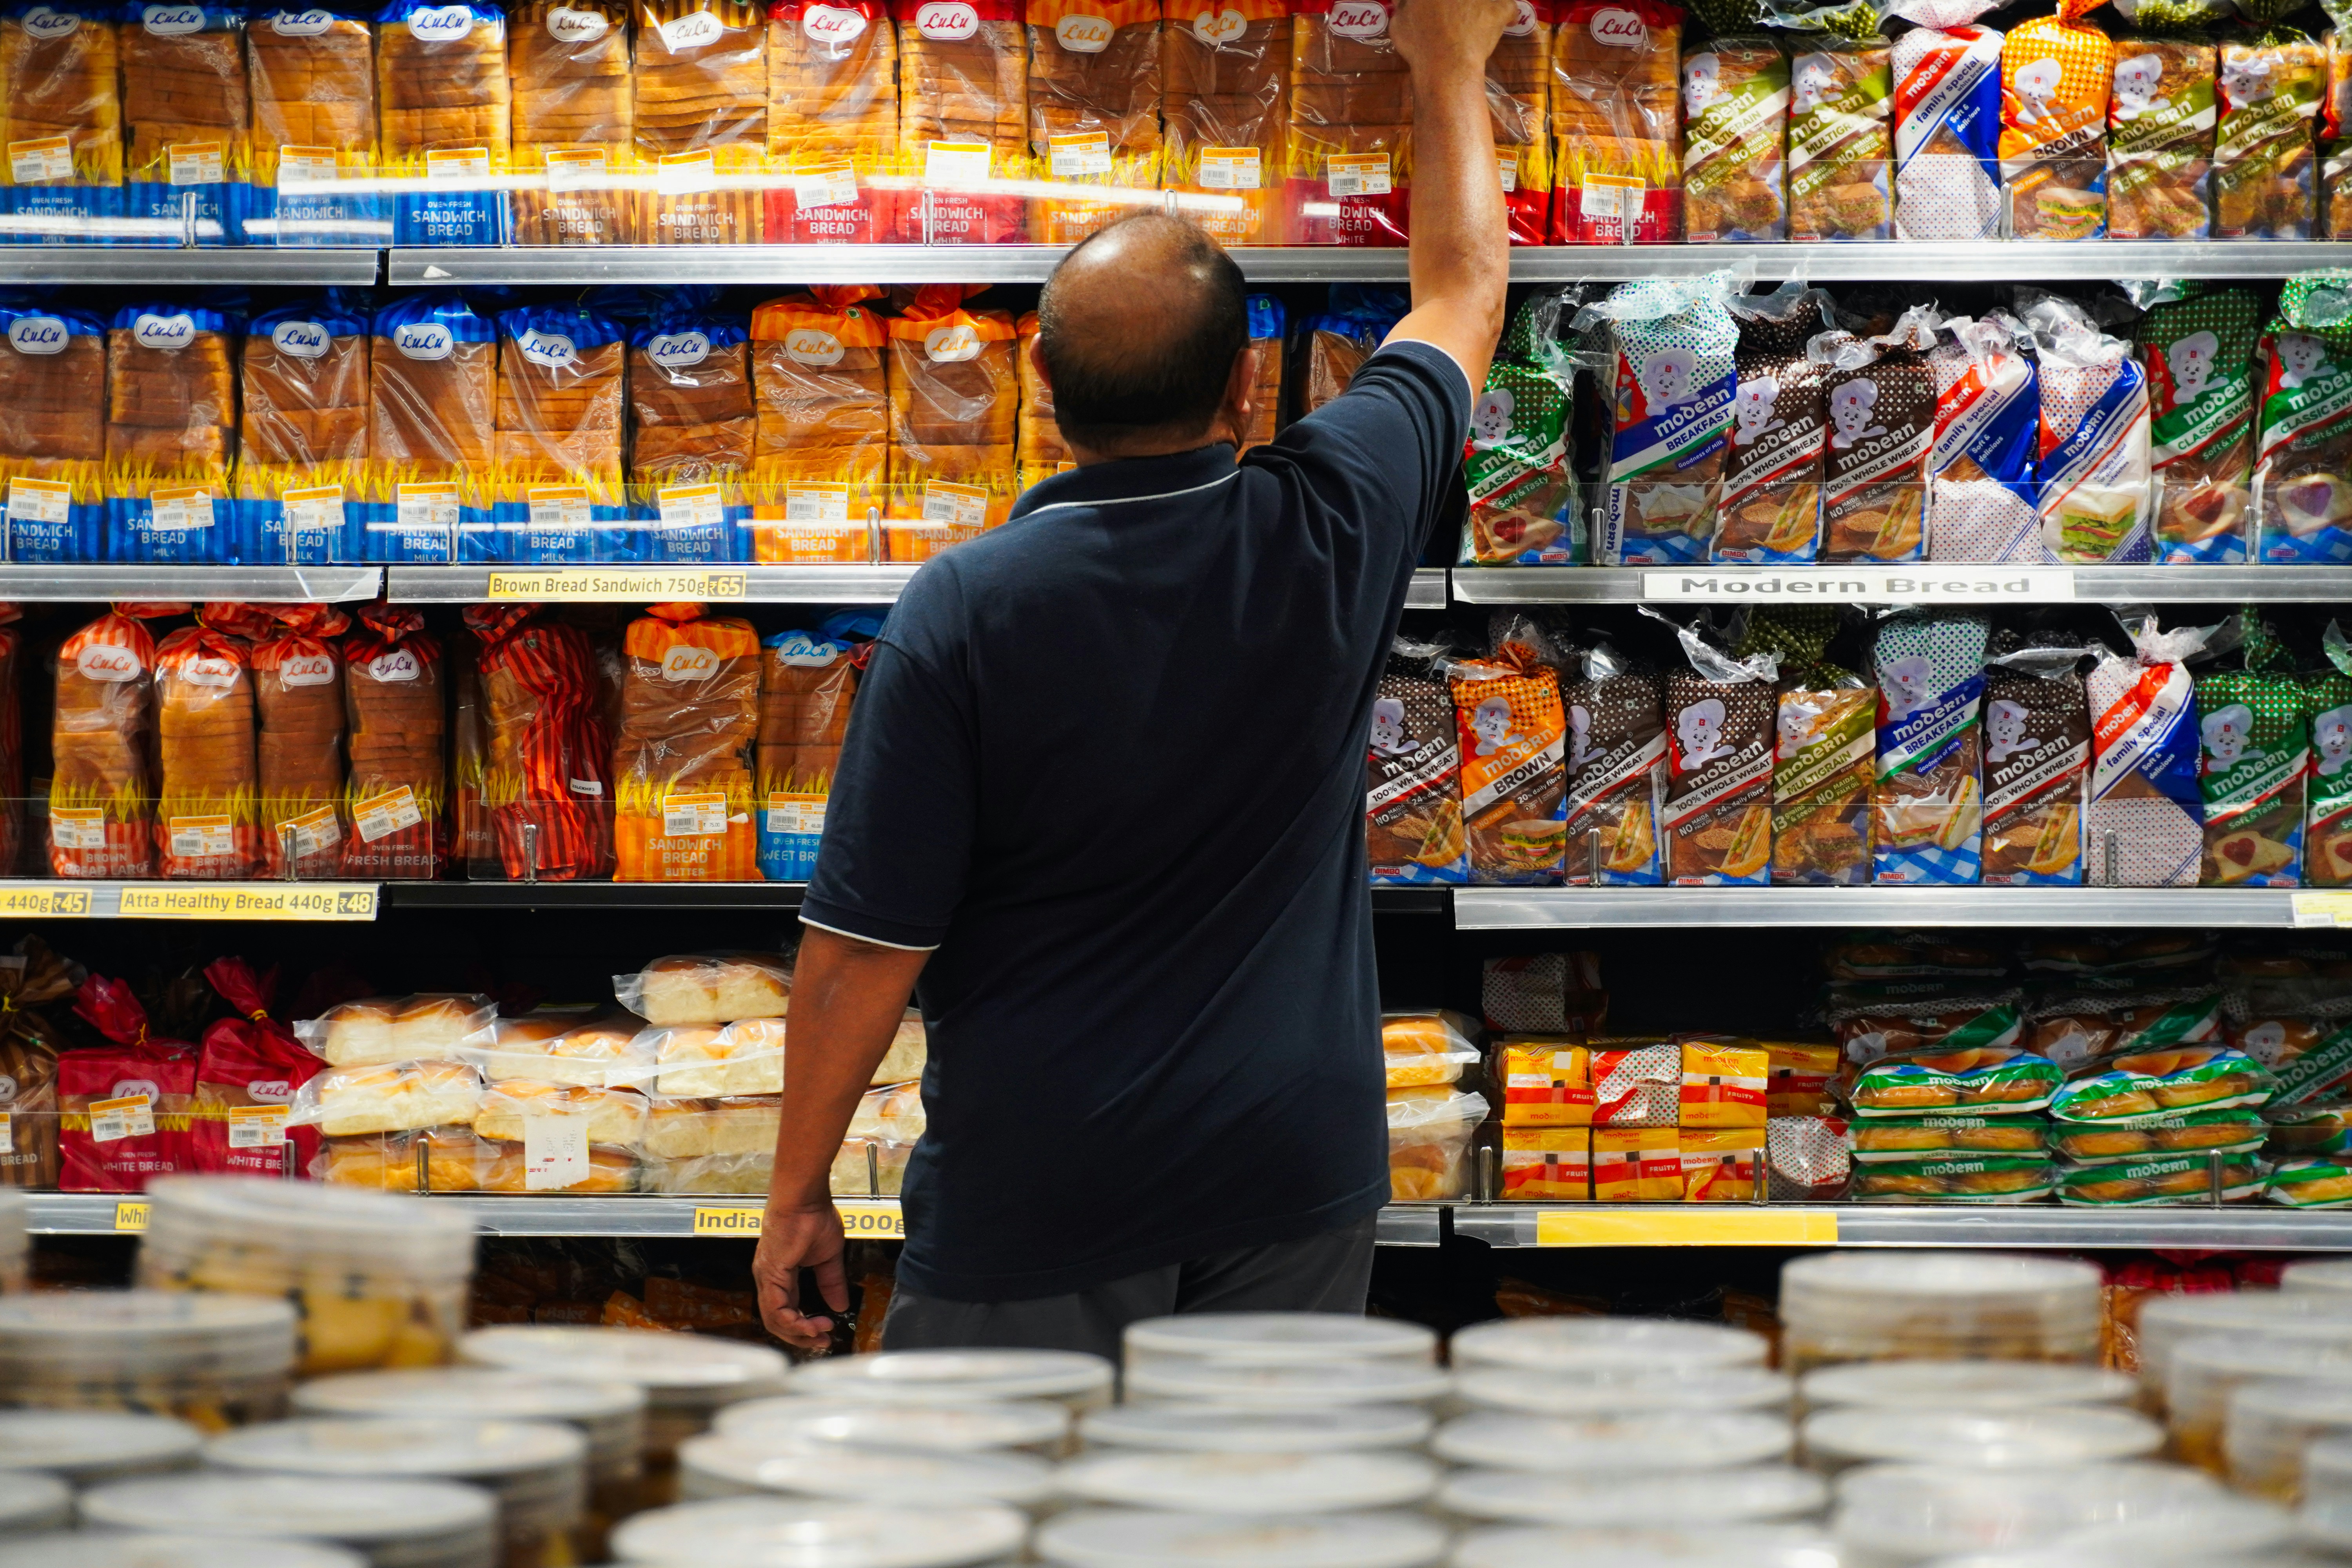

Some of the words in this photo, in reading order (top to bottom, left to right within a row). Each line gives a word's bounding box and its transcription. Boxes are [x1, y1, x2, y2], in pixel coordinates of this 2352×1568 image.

[28, 13, 74, 30] LuLu
[150, 11, 198, 25] LuLu
[417, 15, 464, 29] LuLu
[810, 15, 858, 31] LuLu
[924, 13, 969, 29] LuLu
[1333, 10, 1380, 27] LuLu
[1062, 24, 1107, 41] LuLu
[1598, 19, 1642, 36] LuLu
[1906, 49, 1951, 98] modern
[1687, 92, 1755, 142] modern
[2118, 100, 2193, 143] modern
[1699, 111, 1762, 154] MULTIGRAIN
[2126, 122, 2196, 154] MULTIGRAIN
[17, 207, 88, 219] SANDWICH
[412, 210, 486, 223] SANDWICH
[543, 207, 616, 221] SANDWICH
[660, 212, 733, 226] SANDWICH
[795, 209, 868, 221] SANDWICH
[428, 224, 473, 236] BREAD
[558, 221, 603, 233] BREAD
[809, 222, 855, 234] BREAD
[1329, 218, 1372, 231] BREAD
[673, 227, 719, 239] BREAD
[17, 328, 61, 342] LuLu
[142, 323, 186, 337] LuLu
[401, 334, 445, 348] LuLu
[525, 339, 567, 358] LuLu
[655, 340, 701, 356] LuLu
[1653, 388, 1730, 437] modern
[1740, 416, 1815, 466] modern
[2063, 409, 2106, 457] modern
[1837, 423, 1916, 470] modern
[1728, 472, 1752, 491] 100%
[1751, 451, 1786, 475] WHOLE
[1826, 478, 1851, 494] 100%
[1851, 457, 1886, 481] WHOLE
[1607, 488, 1621, 550] modern
[141, 532, 186, 544] BREAD
[654, 528, 723, 540] SANDWICH
[531, 537, 575, 549] BREAD
[667, 541, 710, 553] BREAD
[791, 539, 836, 551] BREAD
[493, 579, 539, 592] Brown
[545, 579, 587, 592] Bread
[593, 578, 662, 592] Sandwich
[668, 579, 705, 596] 750g
[1681, 578, 1866, 593] Modern
[1886, 578, 2030, 593] Bread
[785, 643, 828, 657] LuLu
[85, 655, 132, 671] LuLu
[287, 661, 328, 676] LuLu
[1893, 694, 1966, 742] modern
[1482, 730, 1554, 777] modern
[1775, 733, 1846, 784] modern
[1993, 735, 2070, 785] modern
[1688, 741, 1764, 788] modern
[2212, 749, 2289, 796] modern
[1787, 751, 1852, 795] MULTIGRAIN
[1675, 795, 1701, 811] 100%
[1700, 776, 1736, 799] WHOLE
[649, 838, 722, 851] SANDWICH
[394, 856, 438, 865] BREAD
[662, 852, 708, 864] BREAD
[7, 896, 49, 913] 440g
[125, 893, 158, 908] Atta
[165, 894, 230, 911] Healthy
[236, 894, 283, 909] Bread
[289, 895, 333, 913] 440g
[2275, 1039, 2352, 1093] modern
[1929, 1076, 1989, 1086] modern
[254, 1083, 288, 1097] LuLu
[1923, 1118, 1985, 1127] modern
[139, 1161, 173, 1172] BREAD
[2127, 1161, 2189, 1177] modern
[121, 1209, 147, 1224] Whi
[699, 1213, 761, 1228] India
